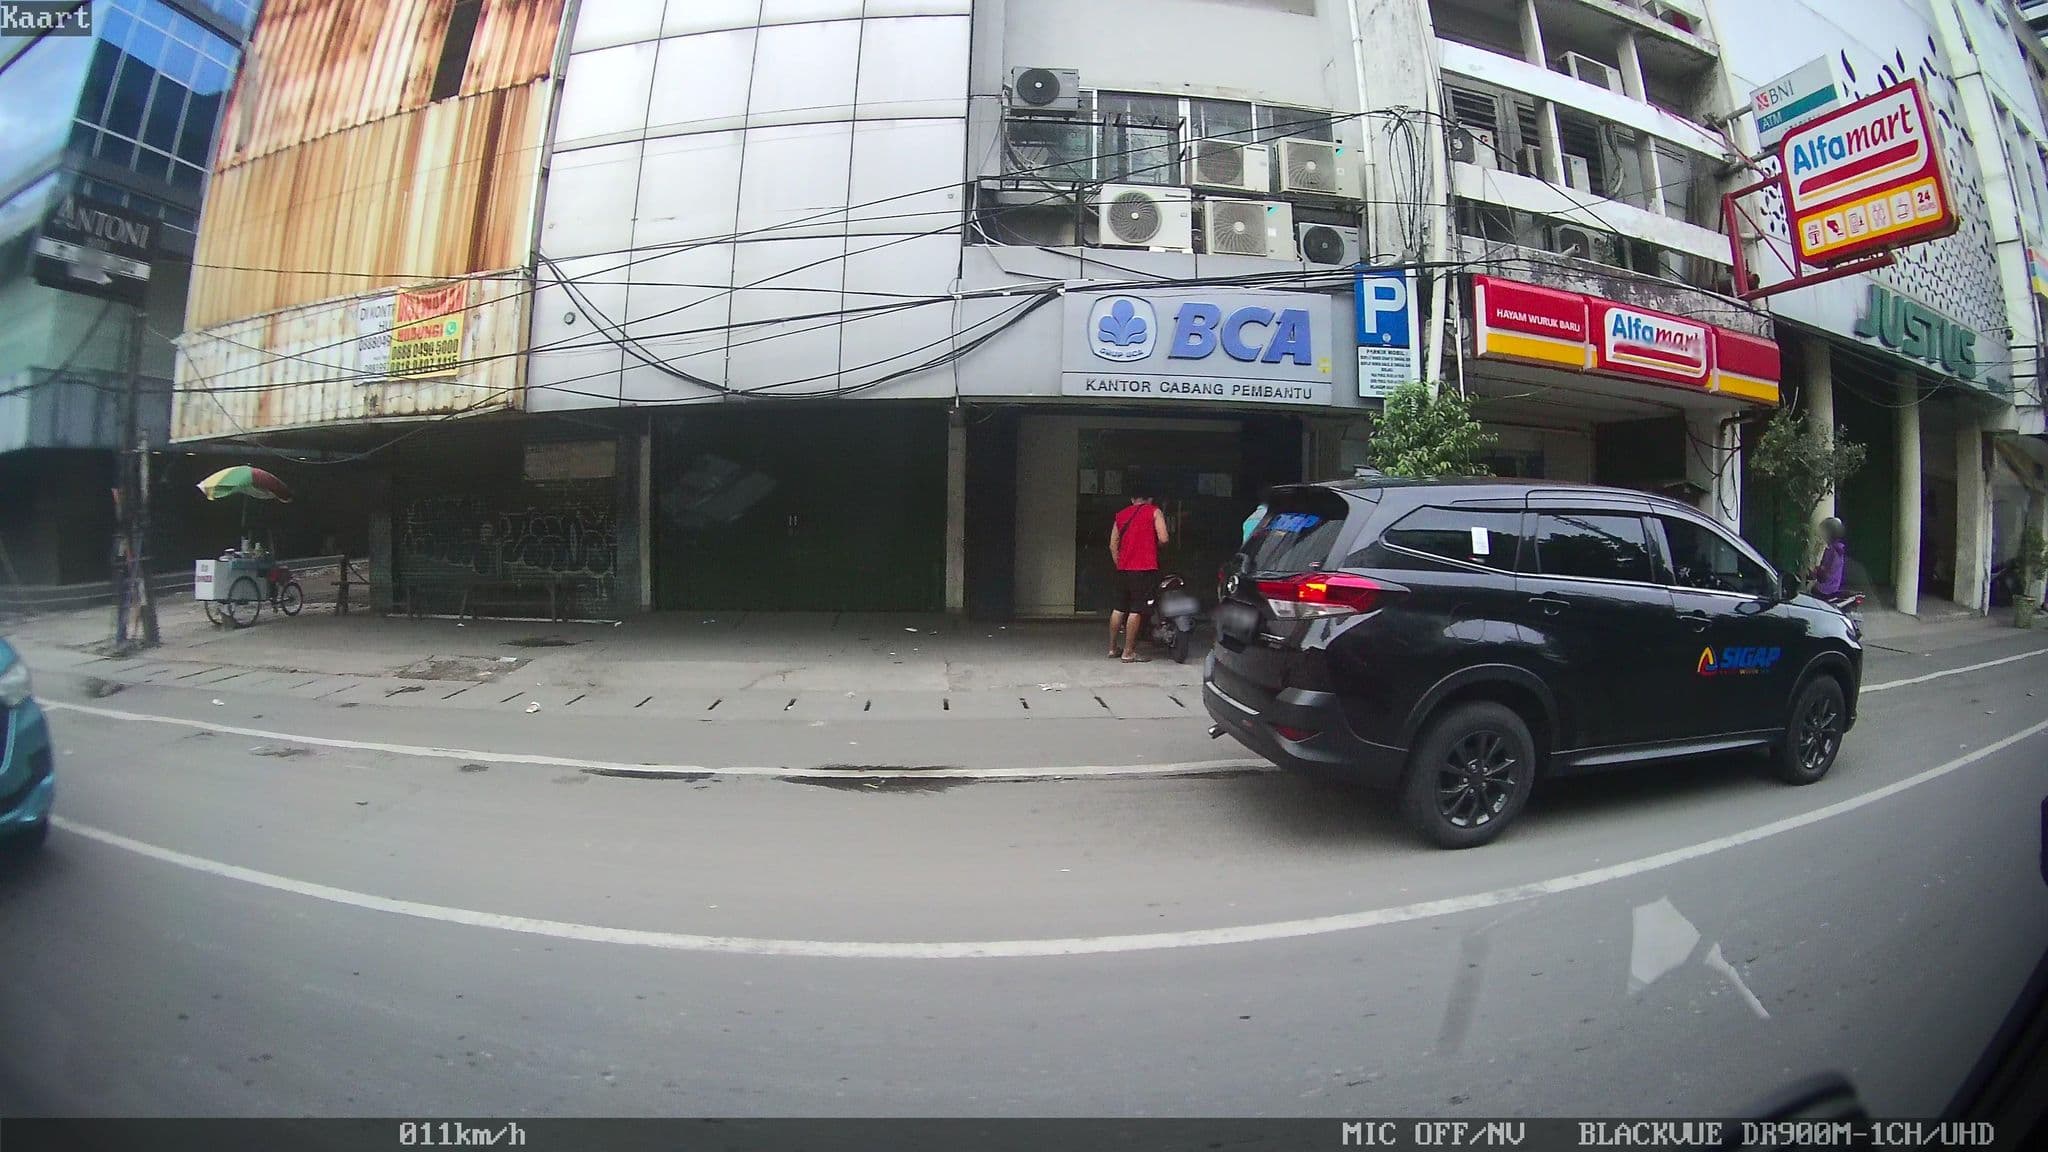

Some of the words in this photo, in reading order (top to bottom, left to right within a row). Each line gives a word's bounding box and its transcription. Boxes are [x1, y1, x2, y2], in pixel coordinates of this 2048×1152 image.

[1768, 80, 1794, 105] BNI
[1761, 111, 1783, 128] ATM
[1793, 103, 1914, 176] Alfamart
[1917, 191, 1931, 203] 24
[54, 196, 150, 249] ANTONI
[1362, 275, 1407, 334] P
[396, 323, 444, 343] HUBUNGI
[1496, 308, 1527, 322] HAYAM
[1528, 314, 1559, 328] WURUK
[1559, 320, 1581, 333] BARU
[1854, 283, 1977, 379] JUSTUS
[1168, 302, 1312, 366] BCA
[1085, 379, 1151, 393] KANTOR
[1159, 381, 1224, 396] CABANG
[1232, 384, 1313, 400] PEMBANTU
[1721, 646, 1781, 668] SIGAP
